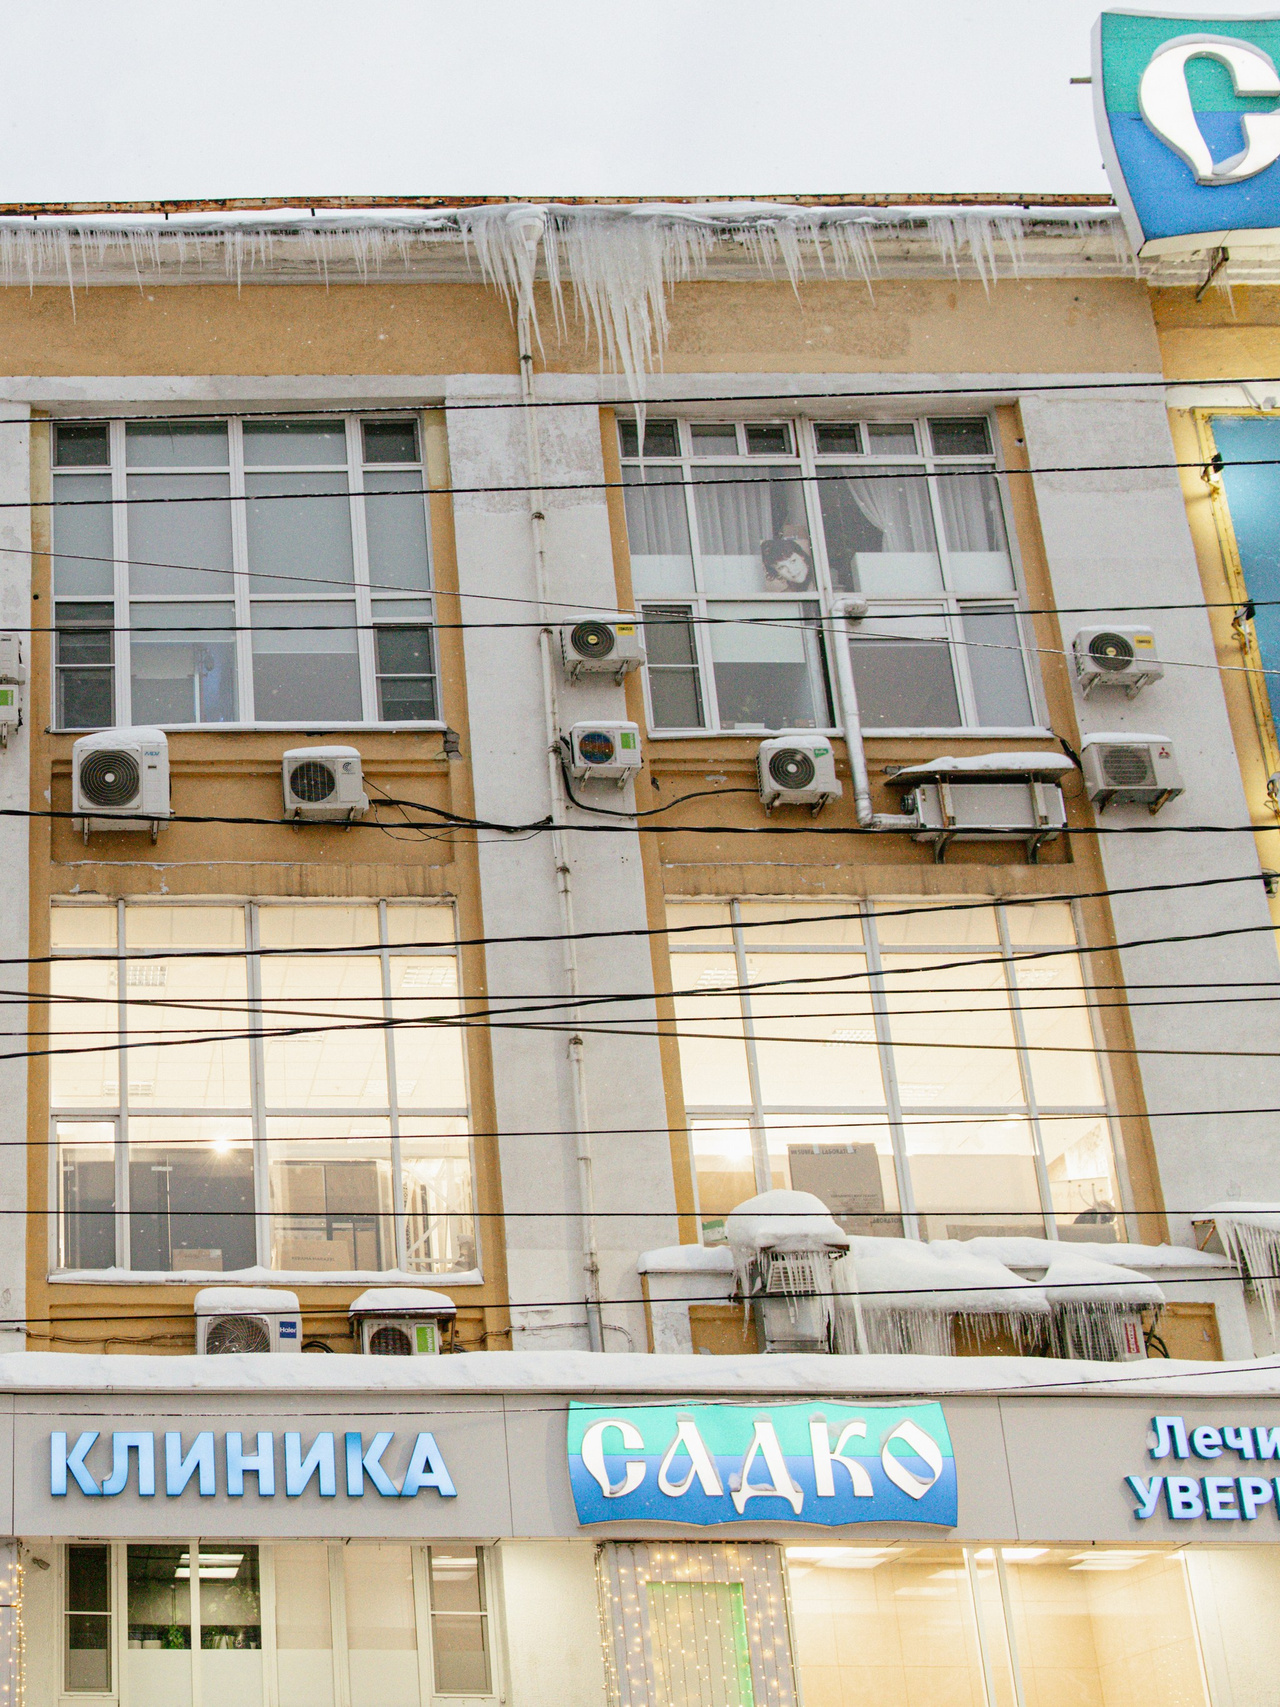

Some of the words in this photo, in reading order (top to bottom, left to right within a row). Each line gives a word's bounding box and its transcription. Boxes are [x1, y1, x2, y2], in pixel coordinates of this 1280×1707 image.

[50, 1431, 458, 1497] КЛИНИКА
[581, 1419, 944, 1515] САДКО
[1124, 1475, 1280, 1521] УВЕР
